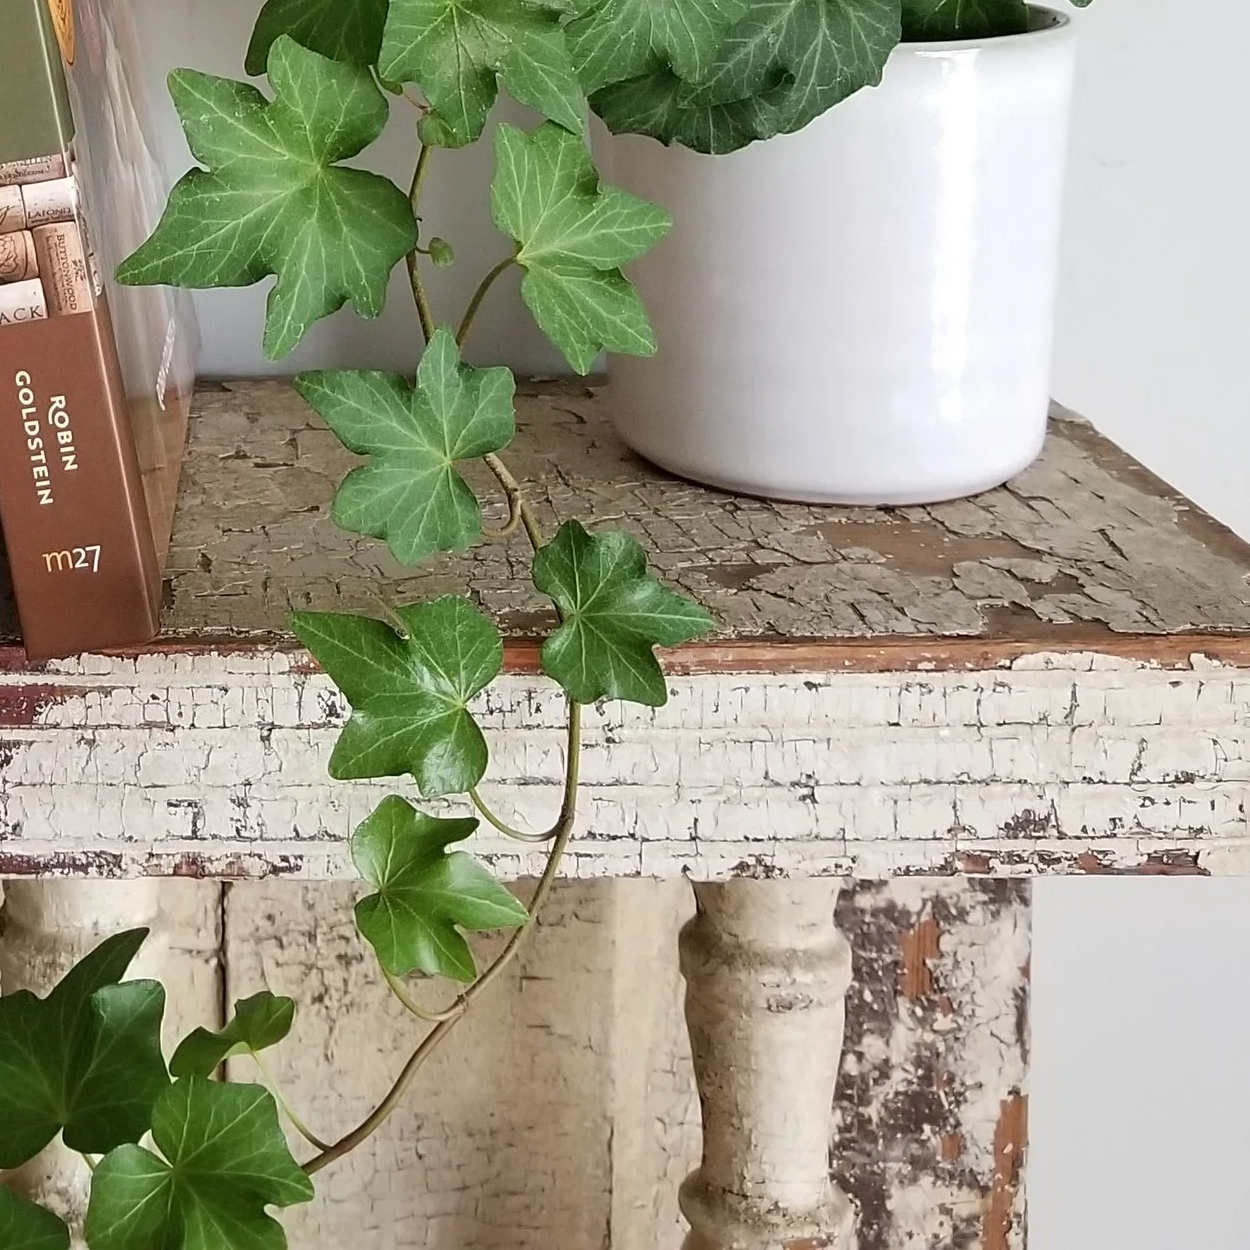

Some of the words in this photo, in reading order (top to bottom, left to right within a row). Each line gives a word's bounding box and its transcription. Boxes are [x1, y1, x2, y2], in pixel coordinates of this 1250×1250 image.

[56, 233, 78, 311] BUTTONWOOD
[15, 370, 53, 506] GOLDSTEIN
[48, 395, 78, 472] ROBIN
[42, 545, 101, 574] m27
